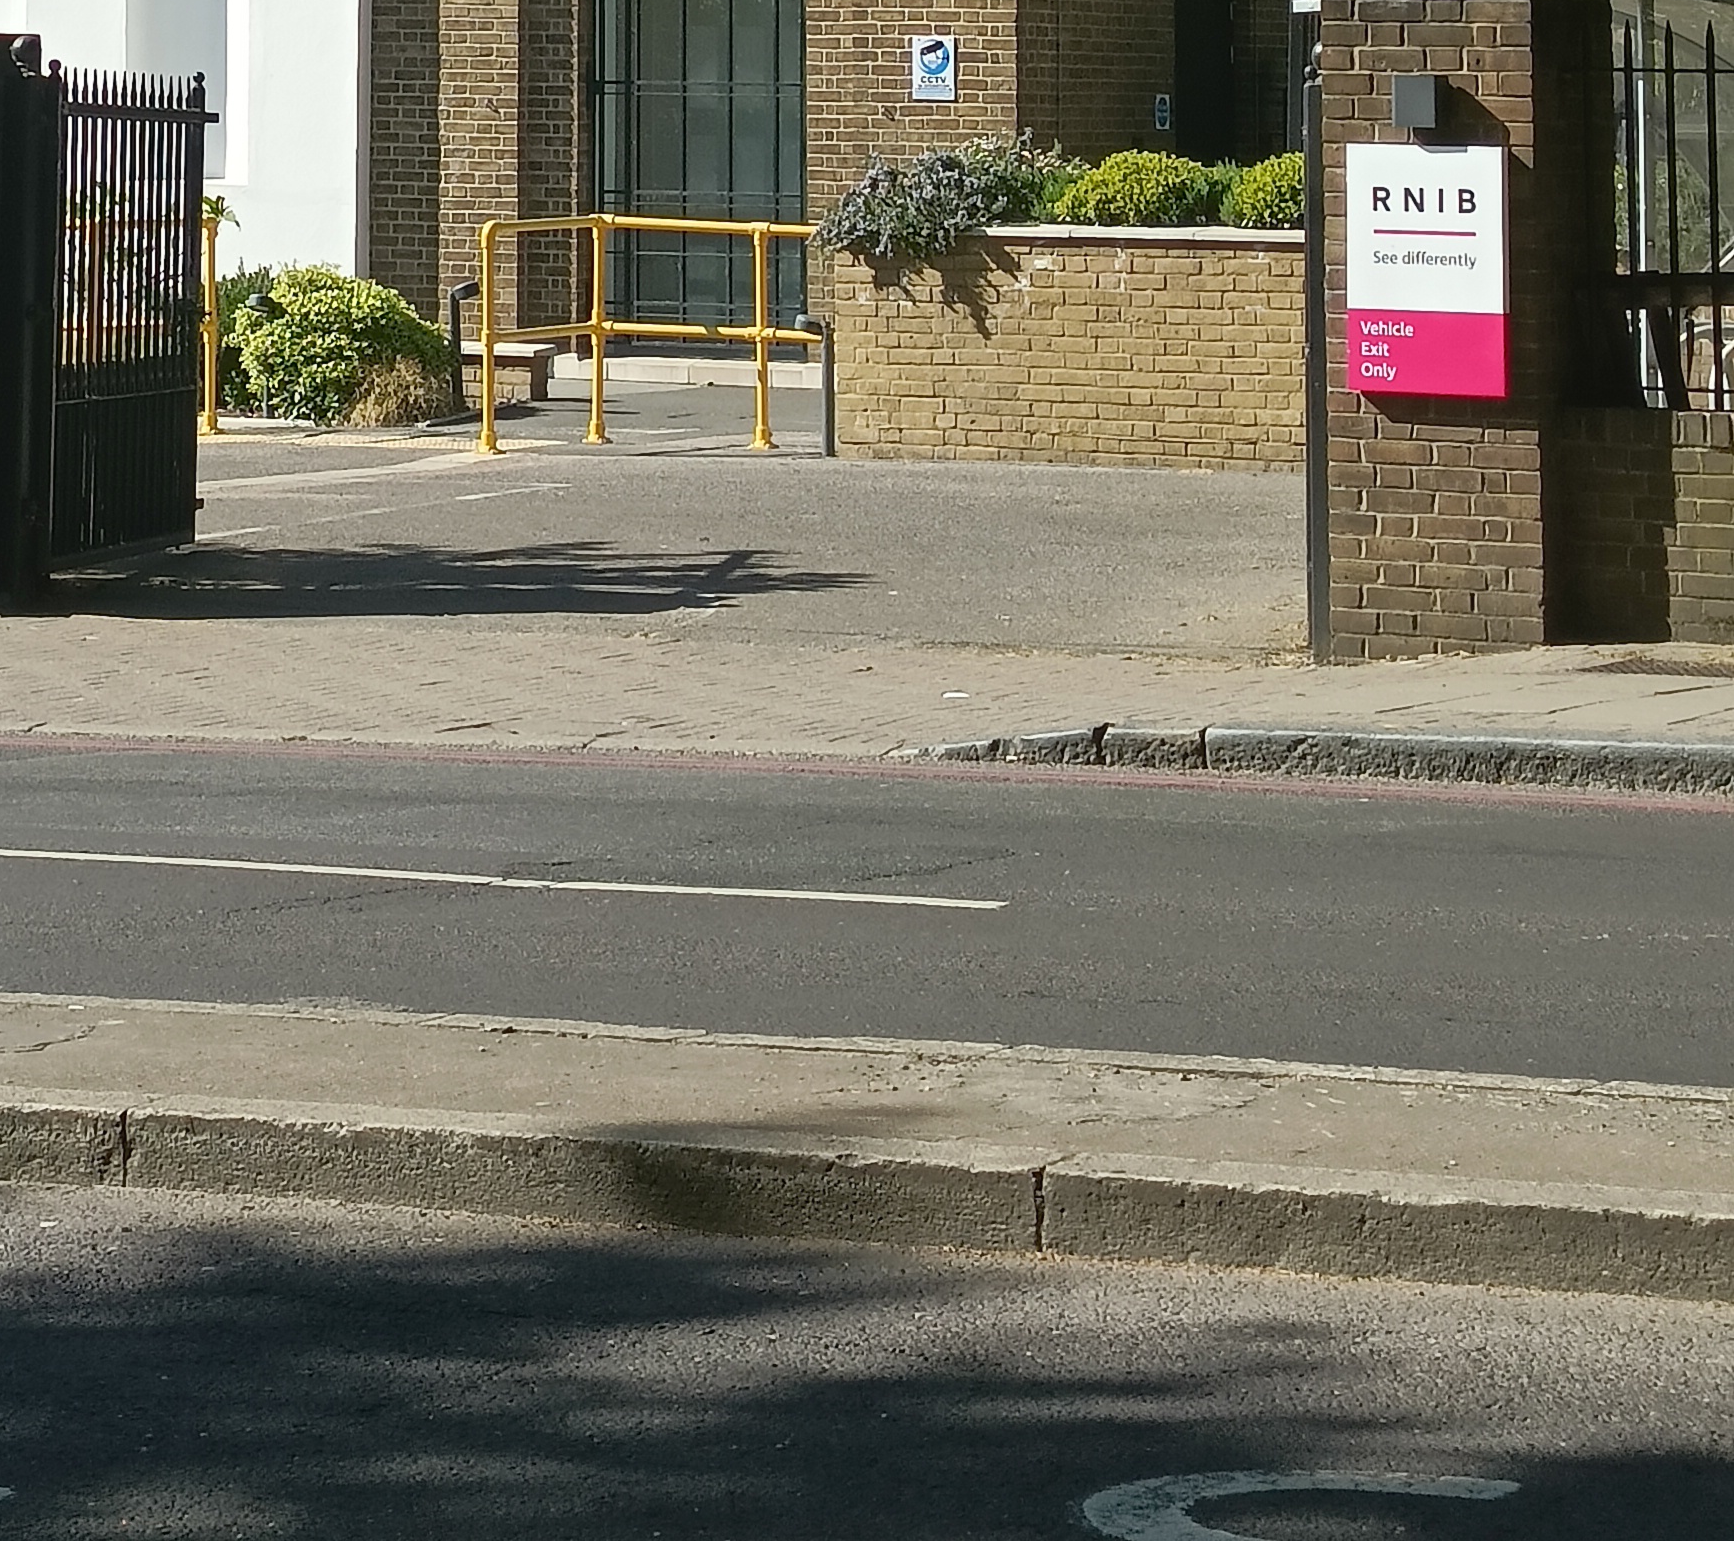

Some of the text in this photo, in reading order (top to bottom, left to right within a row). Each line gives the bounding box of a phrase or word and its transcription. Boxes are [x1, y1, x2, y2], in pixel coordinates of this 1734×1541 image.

[1372, 186, 1476, 213] RNIB
[1373, 250, 1476, 270] See differently
[1360, 320, 1414, 337] Vehicle
[1361, 341, 1390, 357] Exit
[1361, 362, 1397, 381] Only
